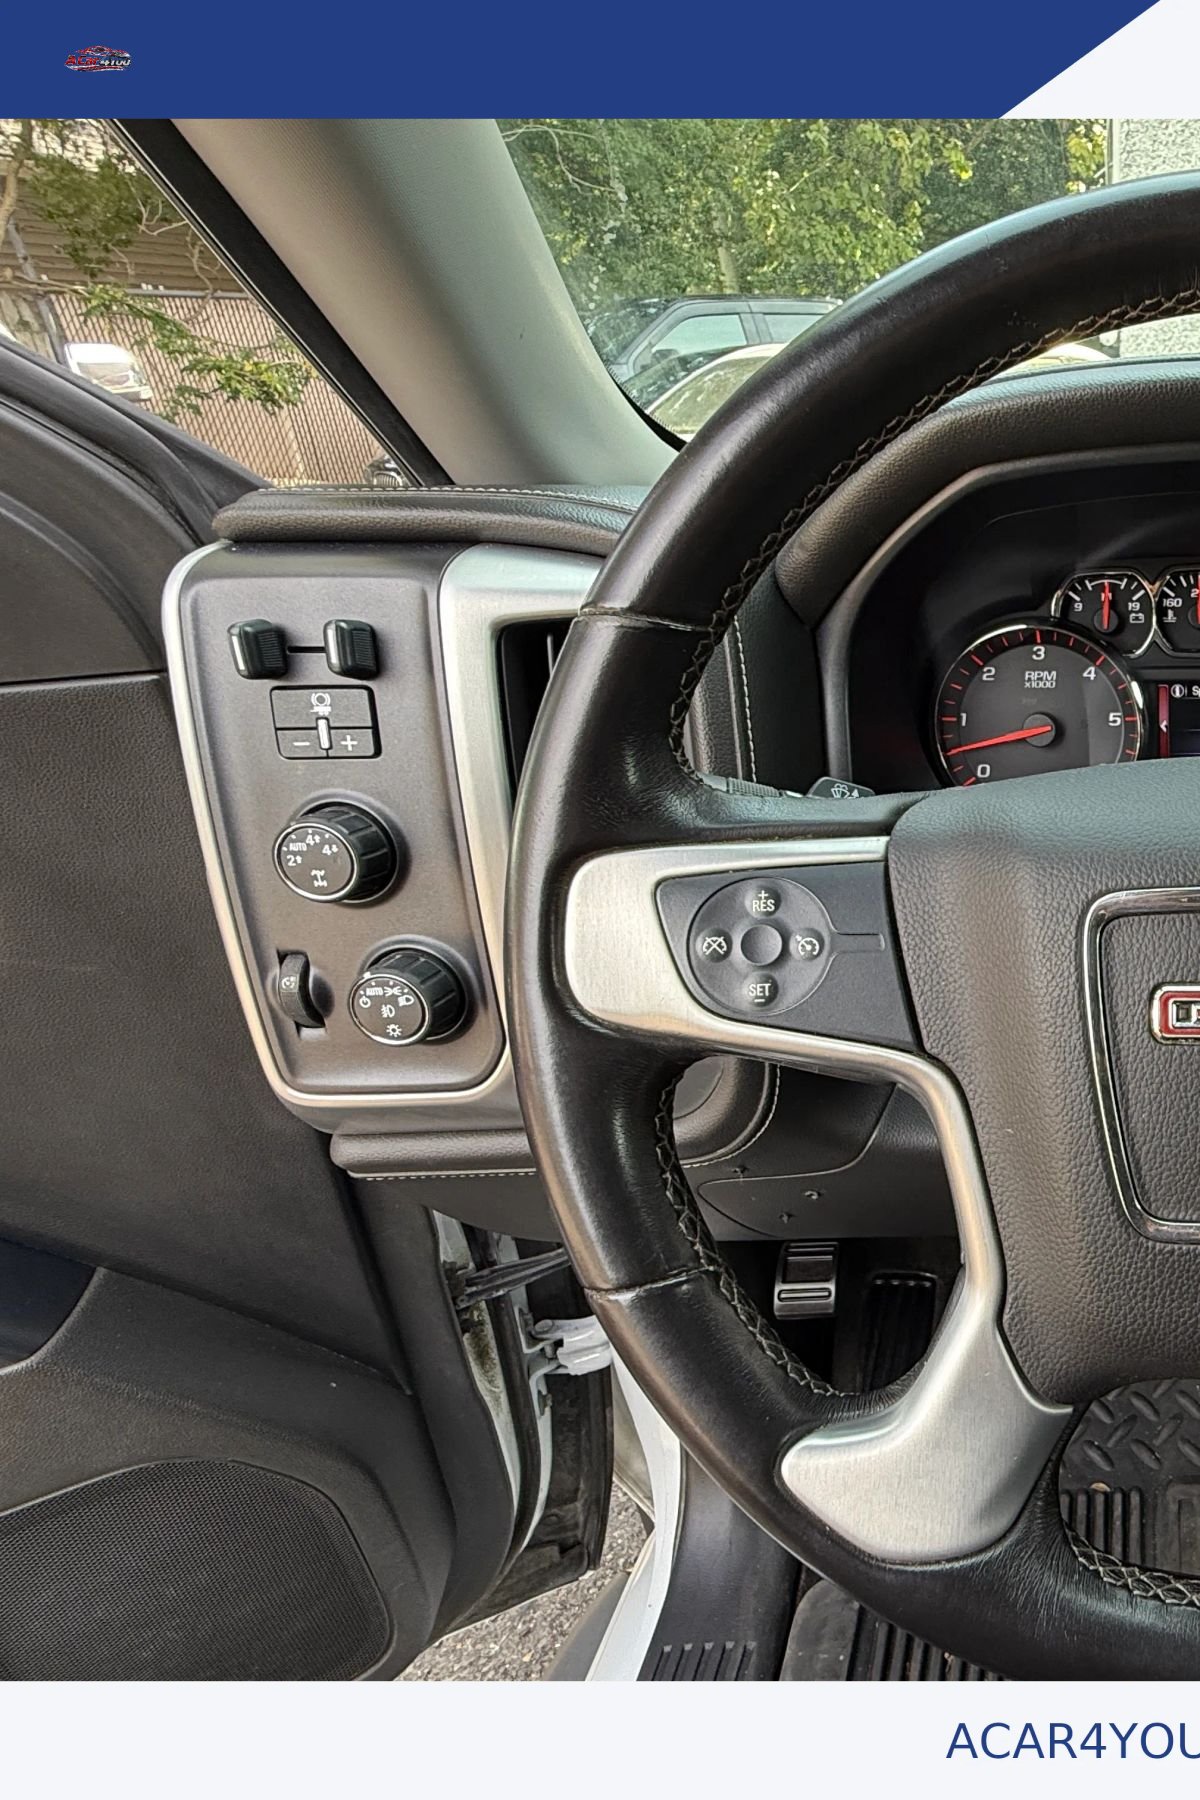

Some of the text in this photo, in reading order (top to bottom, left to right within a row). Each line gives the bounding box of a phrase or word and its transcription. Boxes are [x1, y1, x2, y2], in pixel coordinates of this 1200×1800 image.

[1074, 603, 1083, 612] 9
[1128, 602, 1140, 612] 19
[1162, 598, 1182, 608] 160
[1032, 645, 1045, 660] 3
[982, 667, 996, 681] 2
[1024, 671, 1057, 680] RPM
[1083, 666, 1097, 680] 4
[1024, 680, 1056, 689] x1000
[960, 712, 967, 727] 1
[1108, 712, 1122, 727] 5
[977, 764, 991, 778] 0
[752, 899, 775, 912] RES
[749, 983, 771, 997] SET
